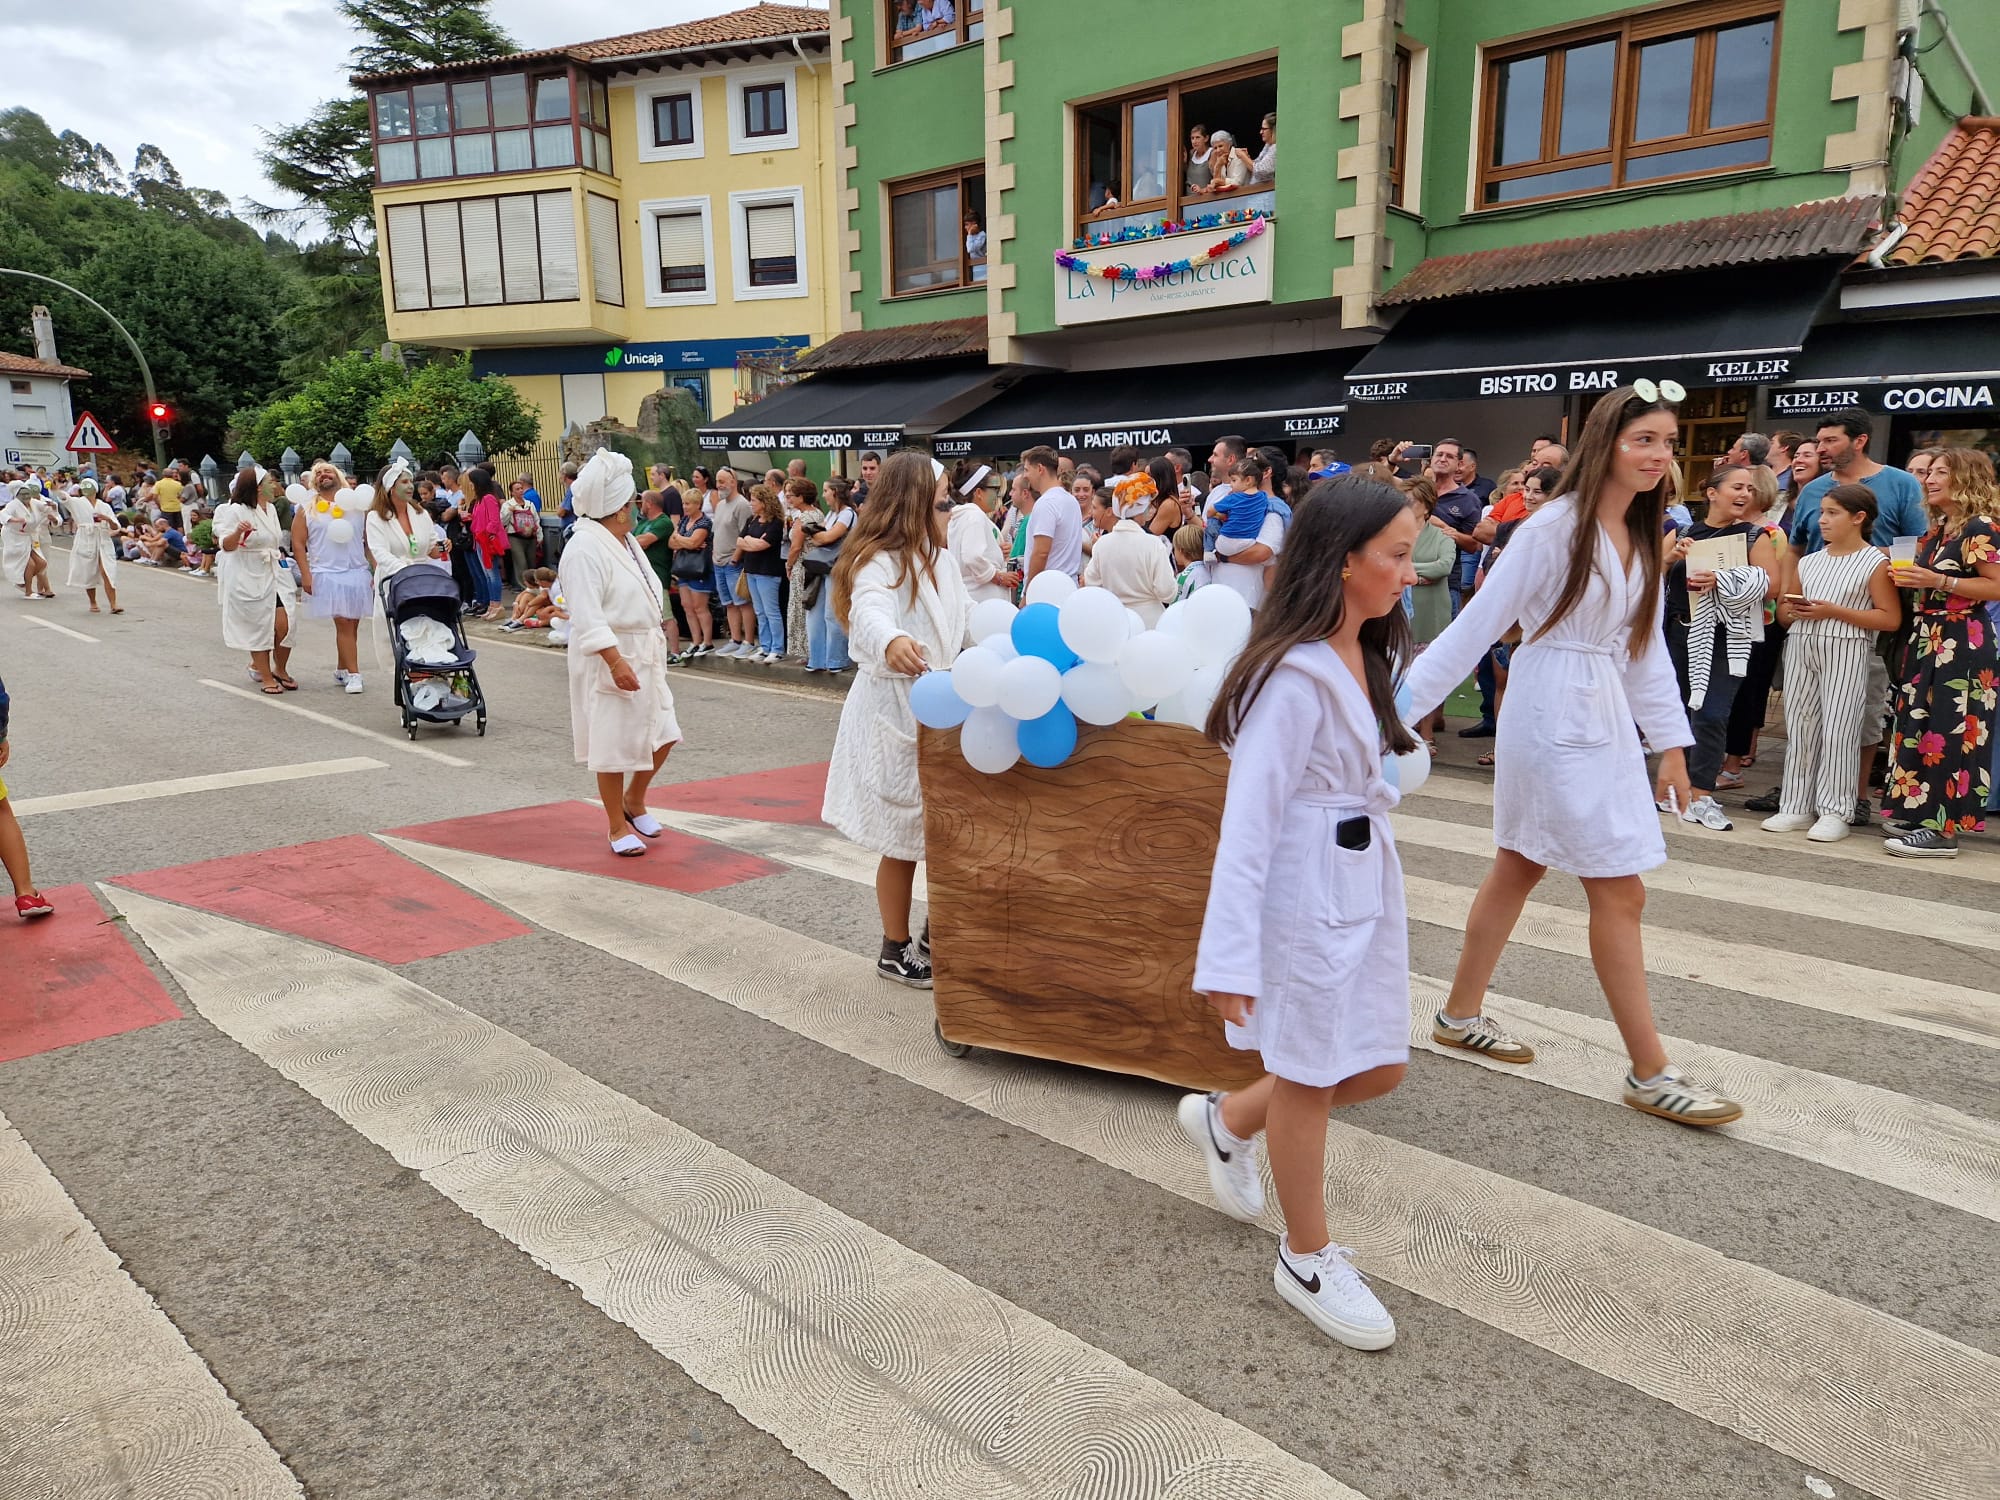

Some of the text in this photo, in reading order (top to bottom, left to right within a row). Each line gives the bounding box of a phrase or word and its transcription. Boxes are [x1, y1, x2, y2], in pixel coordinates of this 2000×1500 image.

[1068, 268, 1095, 300] La
[624, 352, 664, 367] Unicaja
[1707, 359, 1790, 377] KELER
[1479, 370, 1618, 395] BISTRO BAR
[1715, 375, 1759, 383] DONOSTIA
[1348, 382, 1408, 396] KELER
[1774, 385, 1994, 410] KELER COCINA
[1783, 406, 1827, 414] DONOSTIA
[1284, 416, 1340, 432] KELER
[699, 431, 900, 448] KELER COCINA DE MERCADO KELER
[935, 441, 972, 453] KELER
[1058, 428, 1172, 450] LA PARIENTUCA
